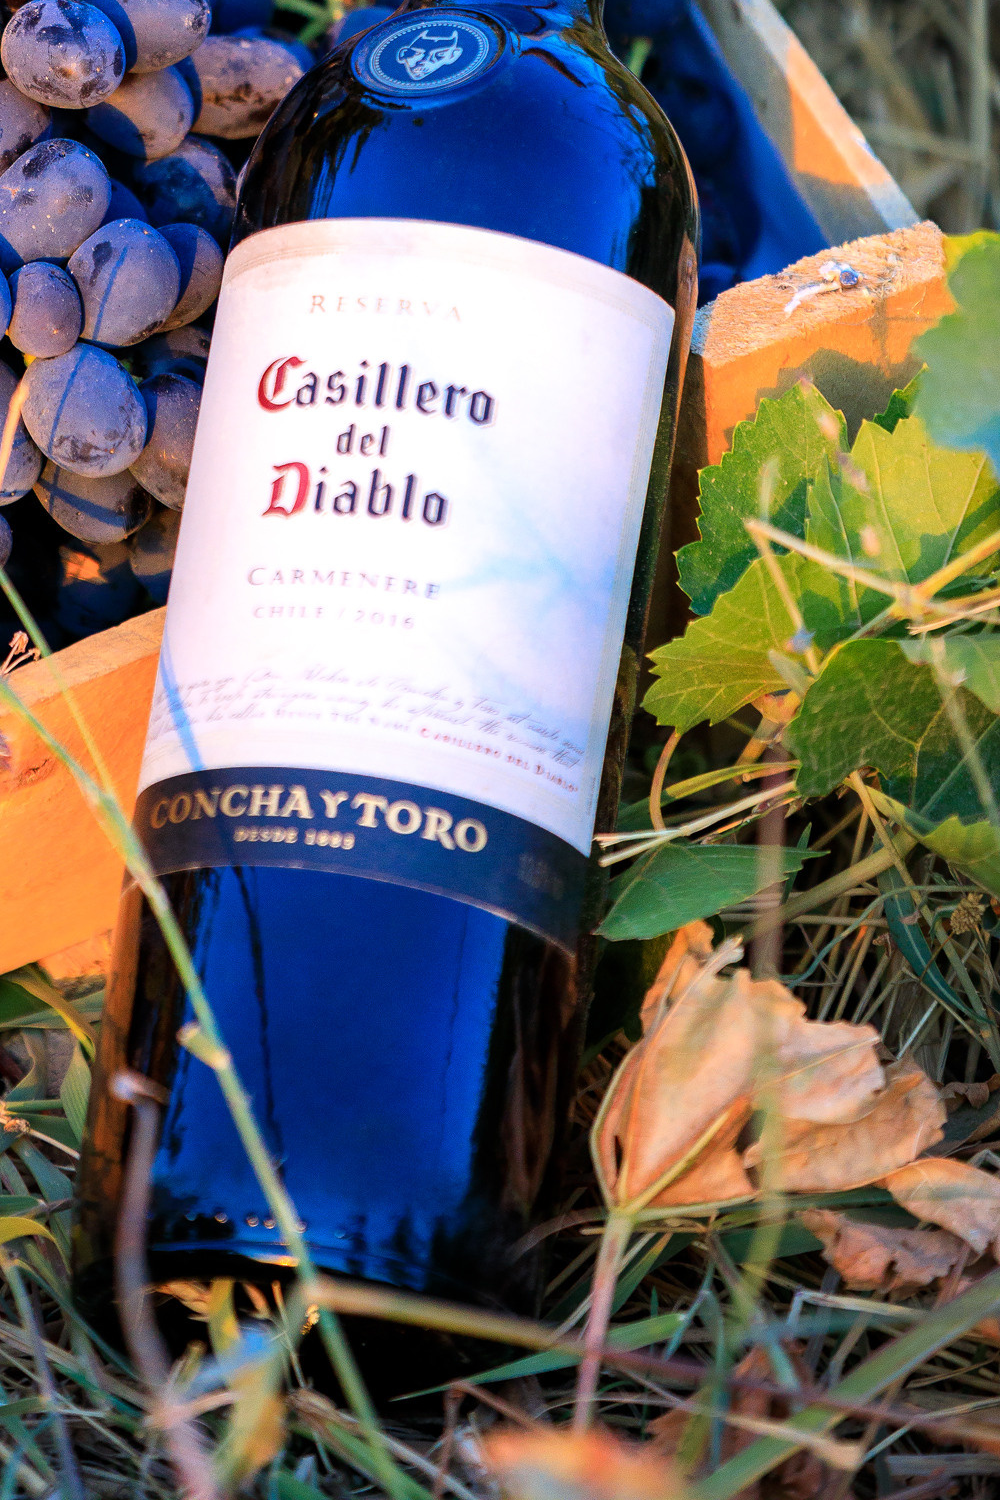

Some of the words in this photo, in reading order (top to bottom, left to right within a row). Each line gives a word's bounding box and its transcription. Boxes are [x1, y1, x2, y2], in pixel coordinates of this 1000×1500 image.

[310, 294, 461, 322] RESERVA
[257, 355, 497, 428] Casillero
[336, 423, 390, 456] del
[260, 461, 451, 527] Diablo
[247, 566, 441, 600] CARMENERE
[252, 605, 325, 619] CHILE
[354, 608, 416, 631] 2016
[151, 784, 313, 829] CONCHA
[319, 790, 349, 818] Y
[351, 792, 488, 852] TORO
[234, 825, 298, 844] DESDE
